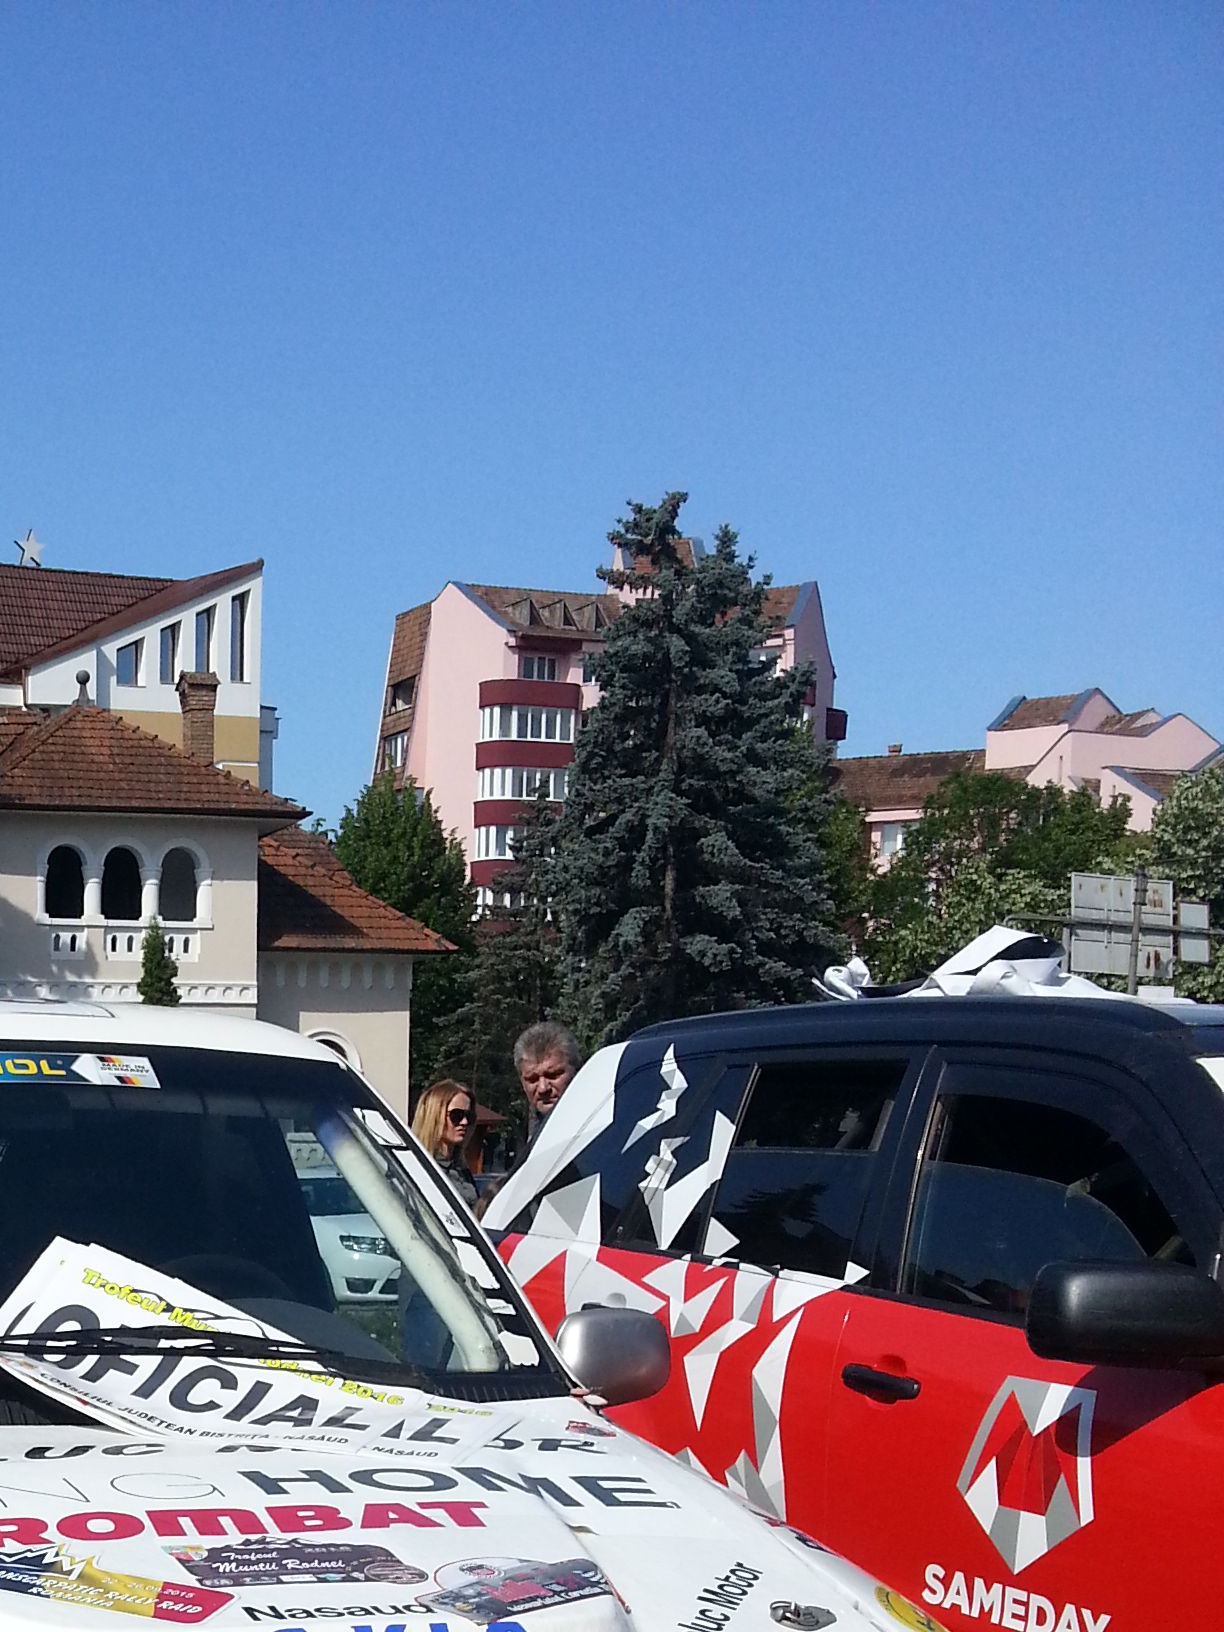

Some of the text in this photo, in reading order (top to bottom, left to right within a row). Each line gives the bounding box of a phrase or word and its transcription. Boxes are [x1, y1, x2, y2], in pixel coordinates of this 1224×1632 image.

[81, 1267, 167, 1316] Trofeul
[339, 1379, 407, 1407] 2016
[104, 1591, 160, 1605] RALLY
[156, 1600, 203, 1614] RAID
[711, 1560, 765, 1622] Motor
